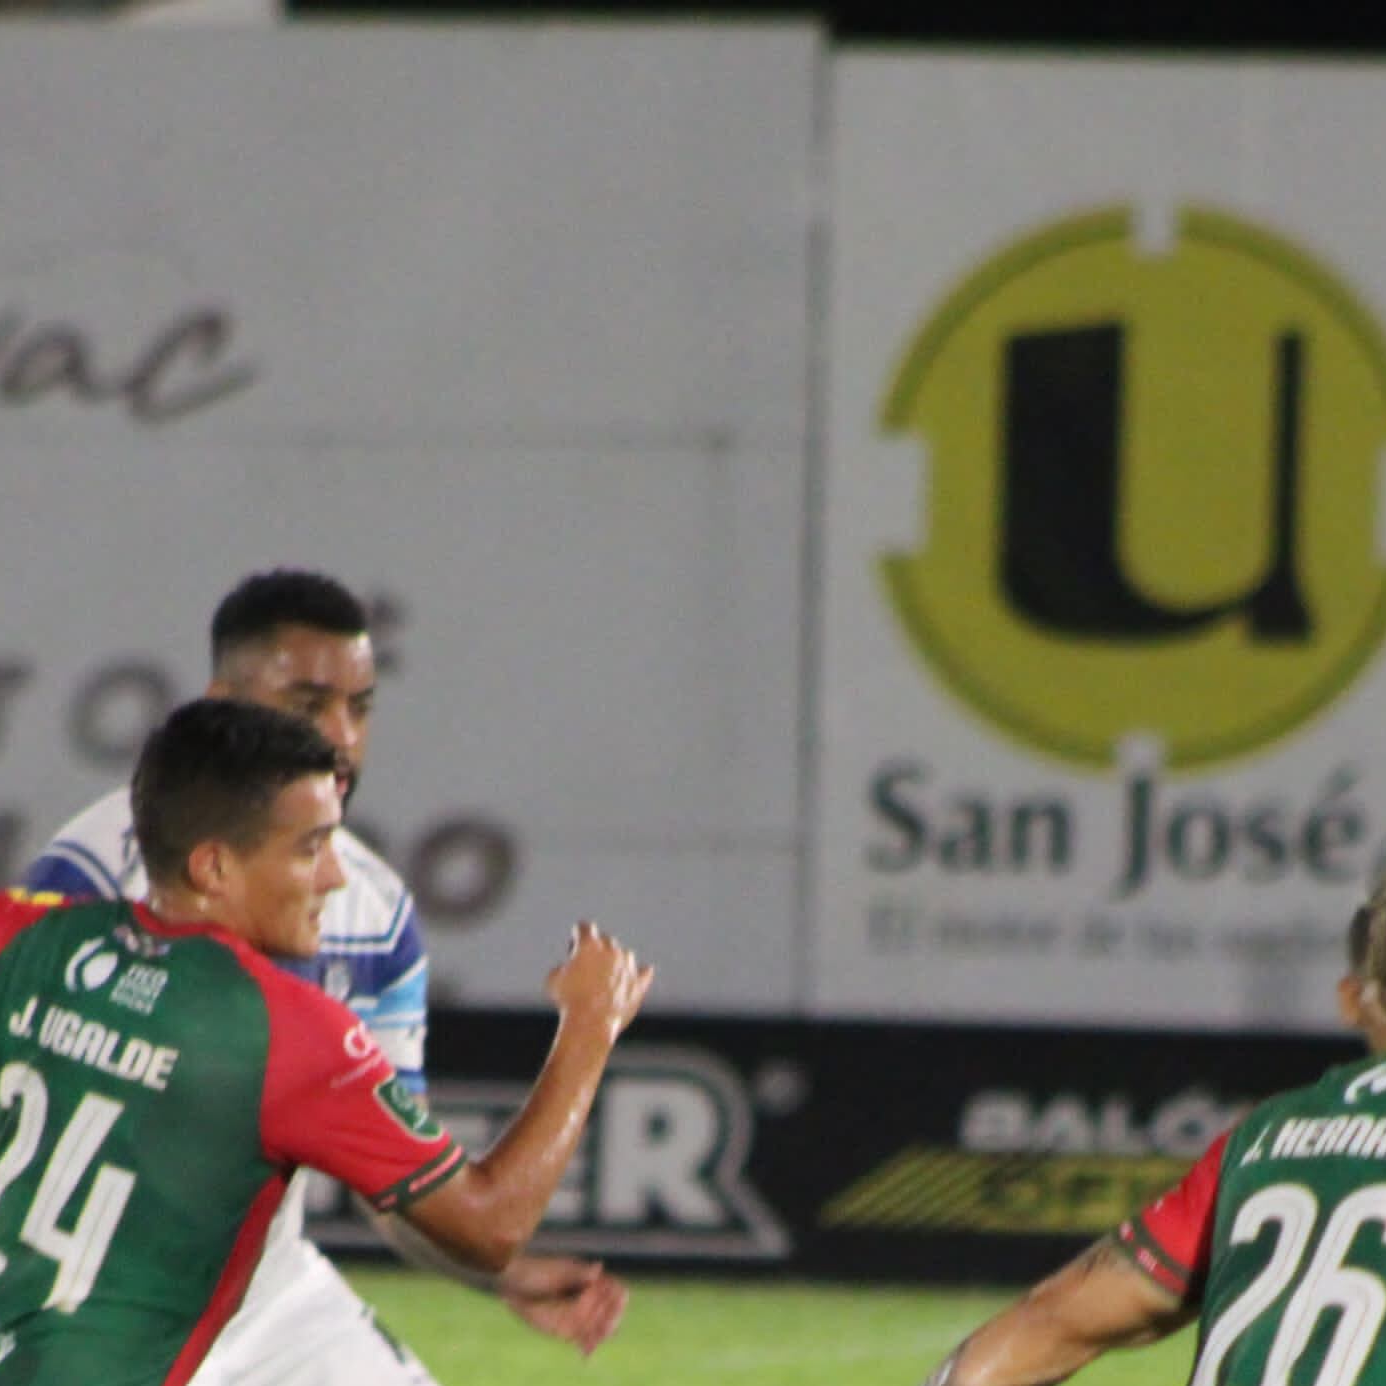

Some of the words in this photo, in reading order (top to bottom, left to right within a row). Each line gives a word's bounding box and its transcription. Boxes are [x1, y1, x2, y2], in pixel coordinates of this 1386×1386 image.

[865, 756, 1073, 876] San
[1115, 758, 1371, 900] José
[39, 1004, 181, 1092] UGALDE
[957, 1082, 1247, 1158] BALÓ
